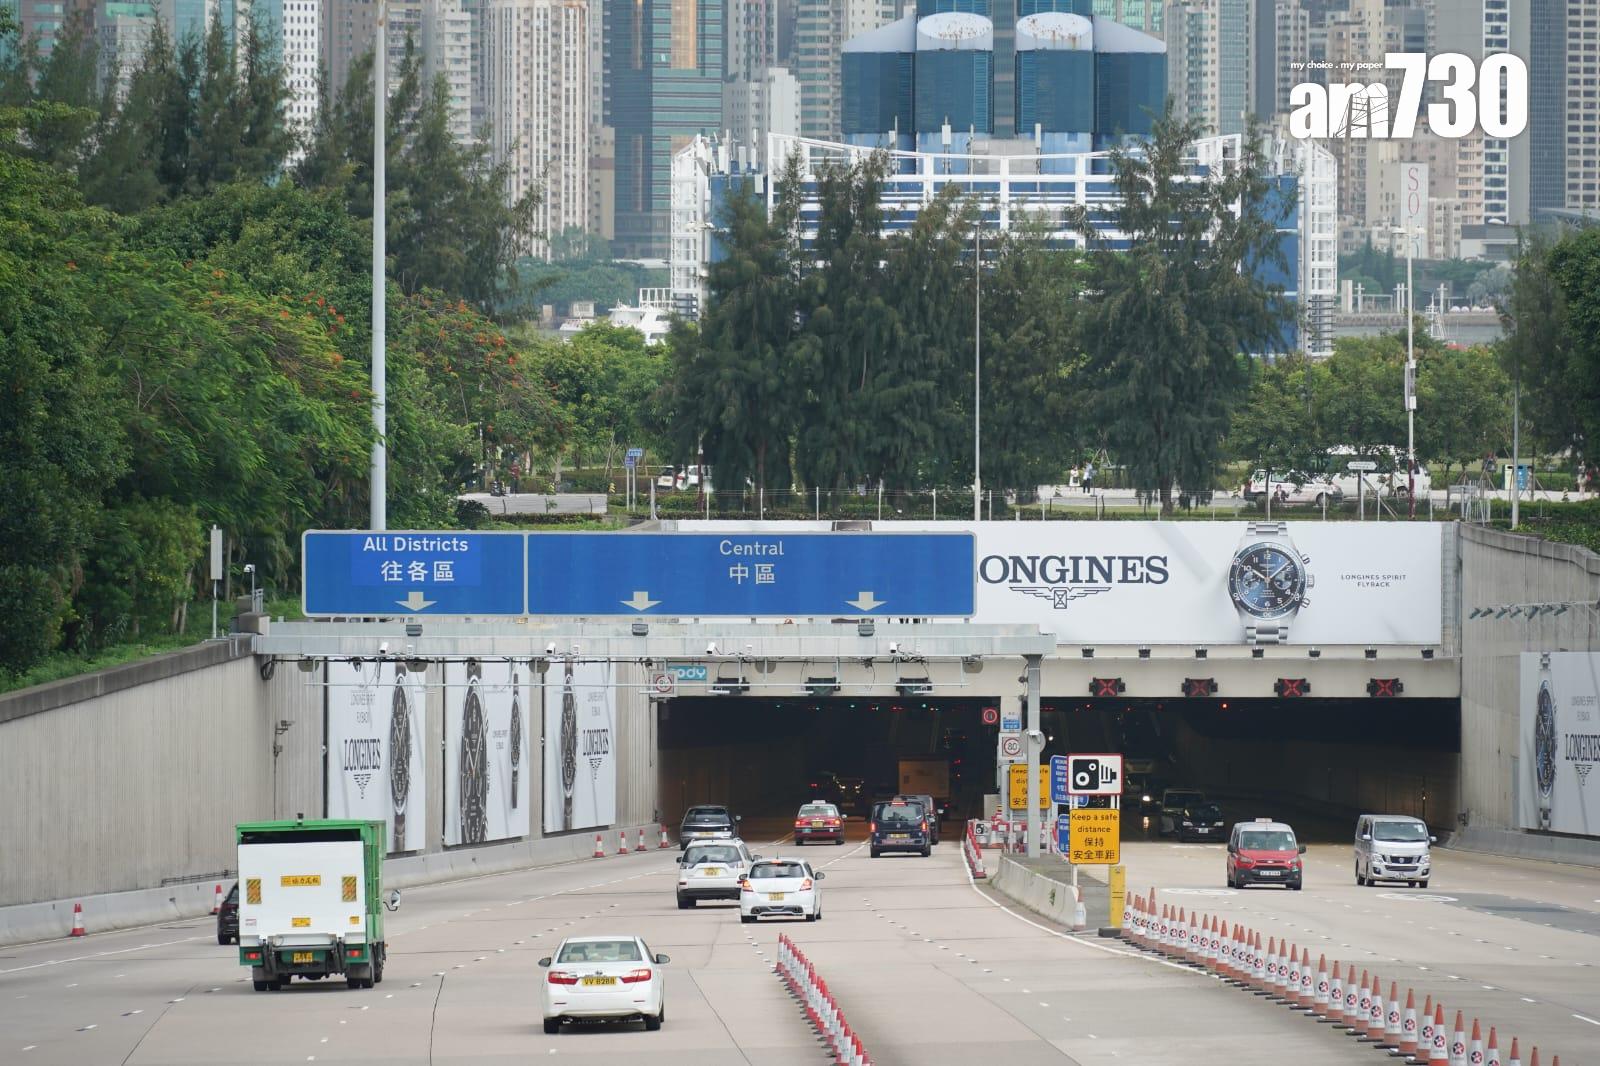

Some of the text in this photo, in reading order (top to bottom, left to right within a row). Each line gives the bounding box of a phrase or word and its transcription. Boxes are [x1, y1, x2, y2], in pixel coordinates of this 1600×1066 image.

[363, 536, 469, 552] All Districts
[719, 539, 784, 556] Central
[381, 560, 454, 582] 往各區
[729, 562, 775, 585] 中區
[977, 555, 1169, 585] ONGINES
[344, 738, 380, 771] LONGINES
[1071, 813, 1091, 821] Keep
[1101, 813, 1118, 821] safe
[1077, 825, 1111, 833] distance
[1084, 837, 1104, 847] 保持
[1073, 849, 1115, 860] 安全車距
